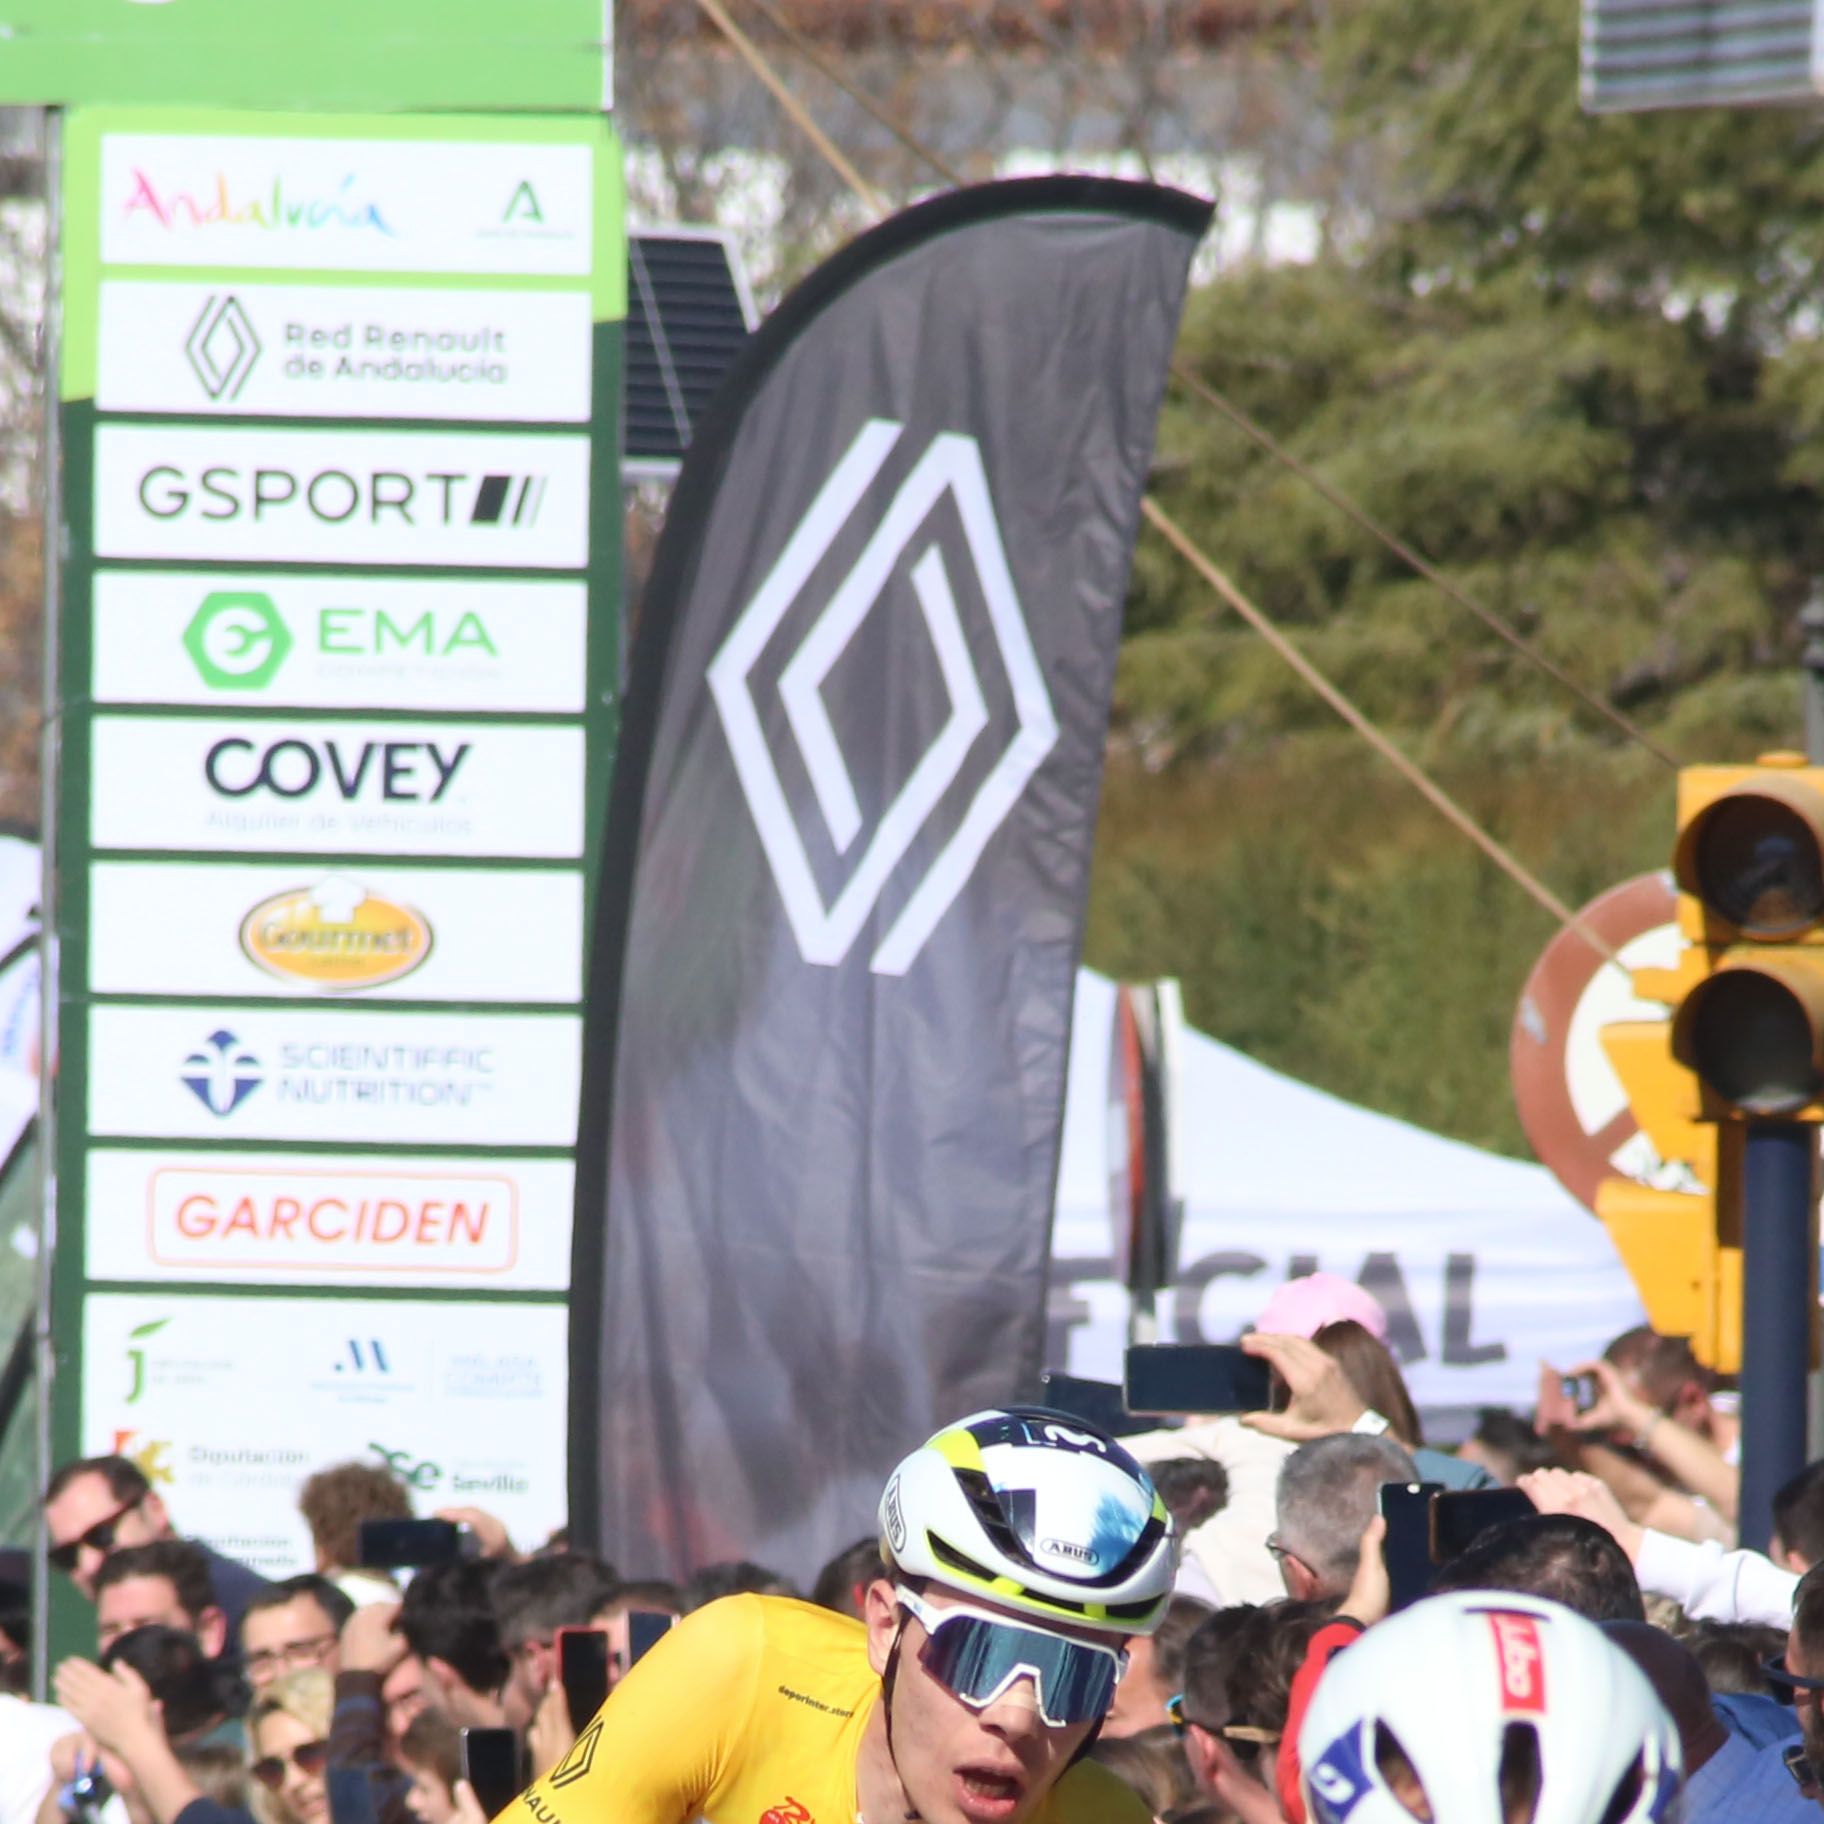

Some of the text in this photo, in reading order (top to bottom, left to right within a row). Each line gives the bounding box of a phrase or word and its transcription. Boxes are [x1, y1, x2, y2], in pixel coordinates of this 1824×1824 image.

[284, 322, 507, 353] Red Renault
[284, 353, 323, 379] de
[137, 466, 468, 525] GSPORT
[317, 608, 498, 657] EMA
[204, 737, 473, 803] COVEY
[175, 1191, 491, 1248] GARCIDEN
[1050, 1541, 1094, 1562] ABUS
